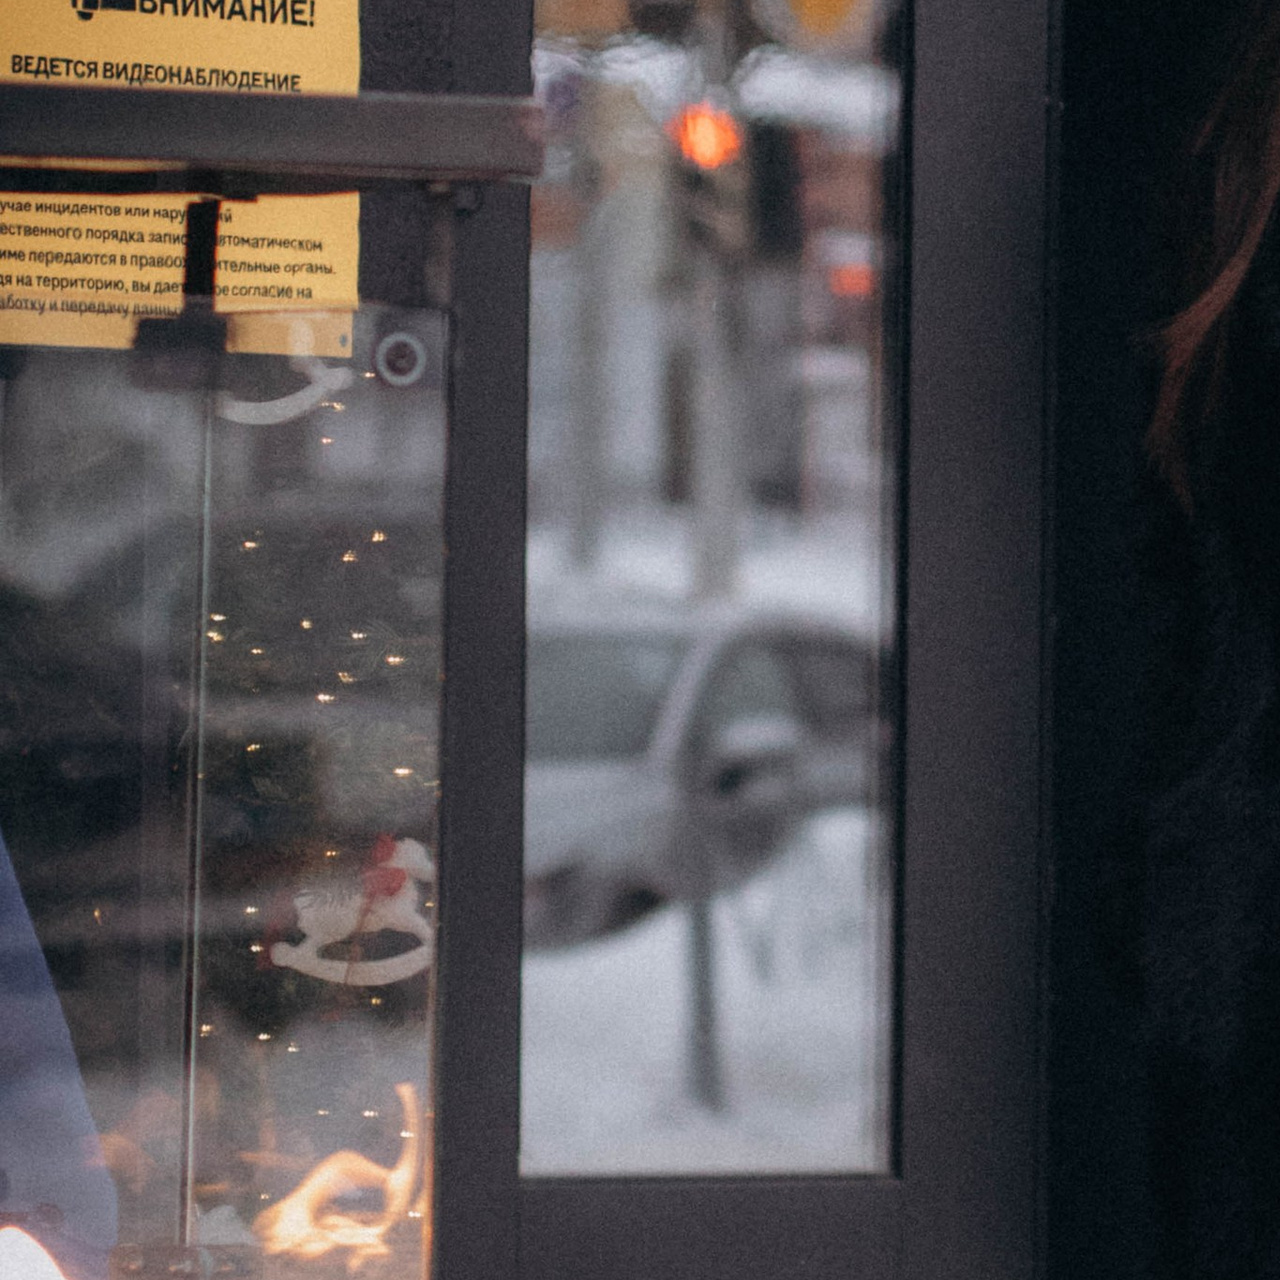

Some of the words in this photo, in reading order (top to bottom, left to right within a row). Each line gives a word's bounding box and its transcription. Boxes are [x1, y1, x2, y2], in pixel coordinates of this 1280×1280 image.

[11, 55, 98, 78] ВЕДЕТСЯ
[102, 62, 301, 92] ВИДЕОНАБЛЮДЕНИЕ
[35, 203, 121, 216] инцидентов
[125, 207, 150, 217] или
[86, 228, 145, 243] порядка
[149, 233, 187, 245] запис
[218, 235, 323, 251] втоматическом
[29, 251, 117, 267] передаются
[120, 255, 127, 266] в
[284, 263, 336, 276] органы.
[16, 275, 32, 287] на
[36, 276, 128, 293] территорию,
[132, 281, 150, 293] вы
[153, 282, 187, 295] дает
[231, 285, 293, 298] согласие
[297, 287, 312, 299] на
[61, 301, 128, 318] передачу
[133, 303, 181, 316] данны
